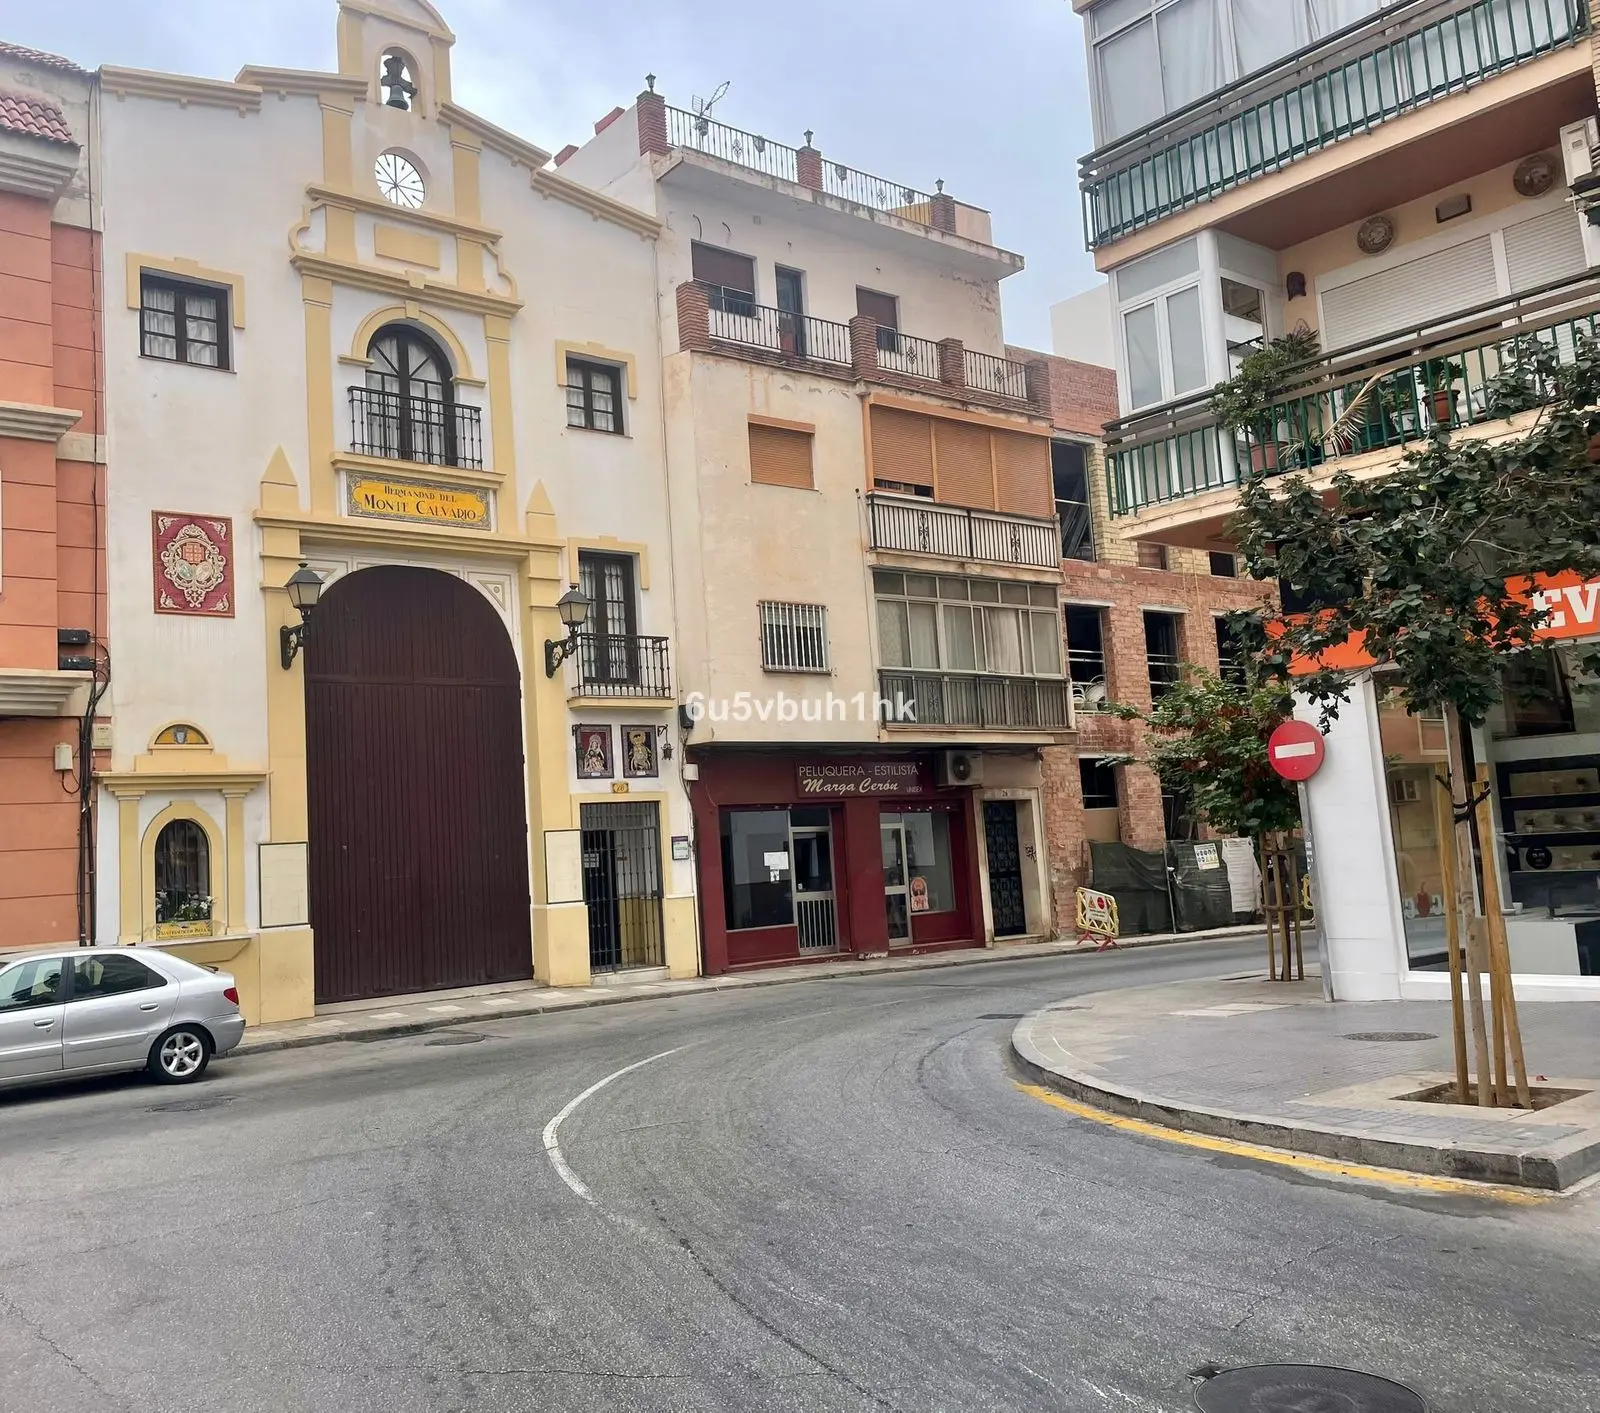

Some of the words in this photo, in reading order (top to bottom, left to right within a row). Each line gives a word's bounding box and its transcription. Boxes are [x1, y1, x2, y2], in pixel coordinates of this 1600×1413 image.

[384, 485, 435, 500] HERMANDAD
[439, 494, 457, 503] DEL
[364, 494, 409, 512] MONTE
[416, 500, 476, 520] CALVARIO
[799, 765, 866, 777] PELUQUERA
[874, 764, 919, 776] ESTILISTA
[802, 778, 856, 796] Marga
[859, 776, 899, 793] Cerón
